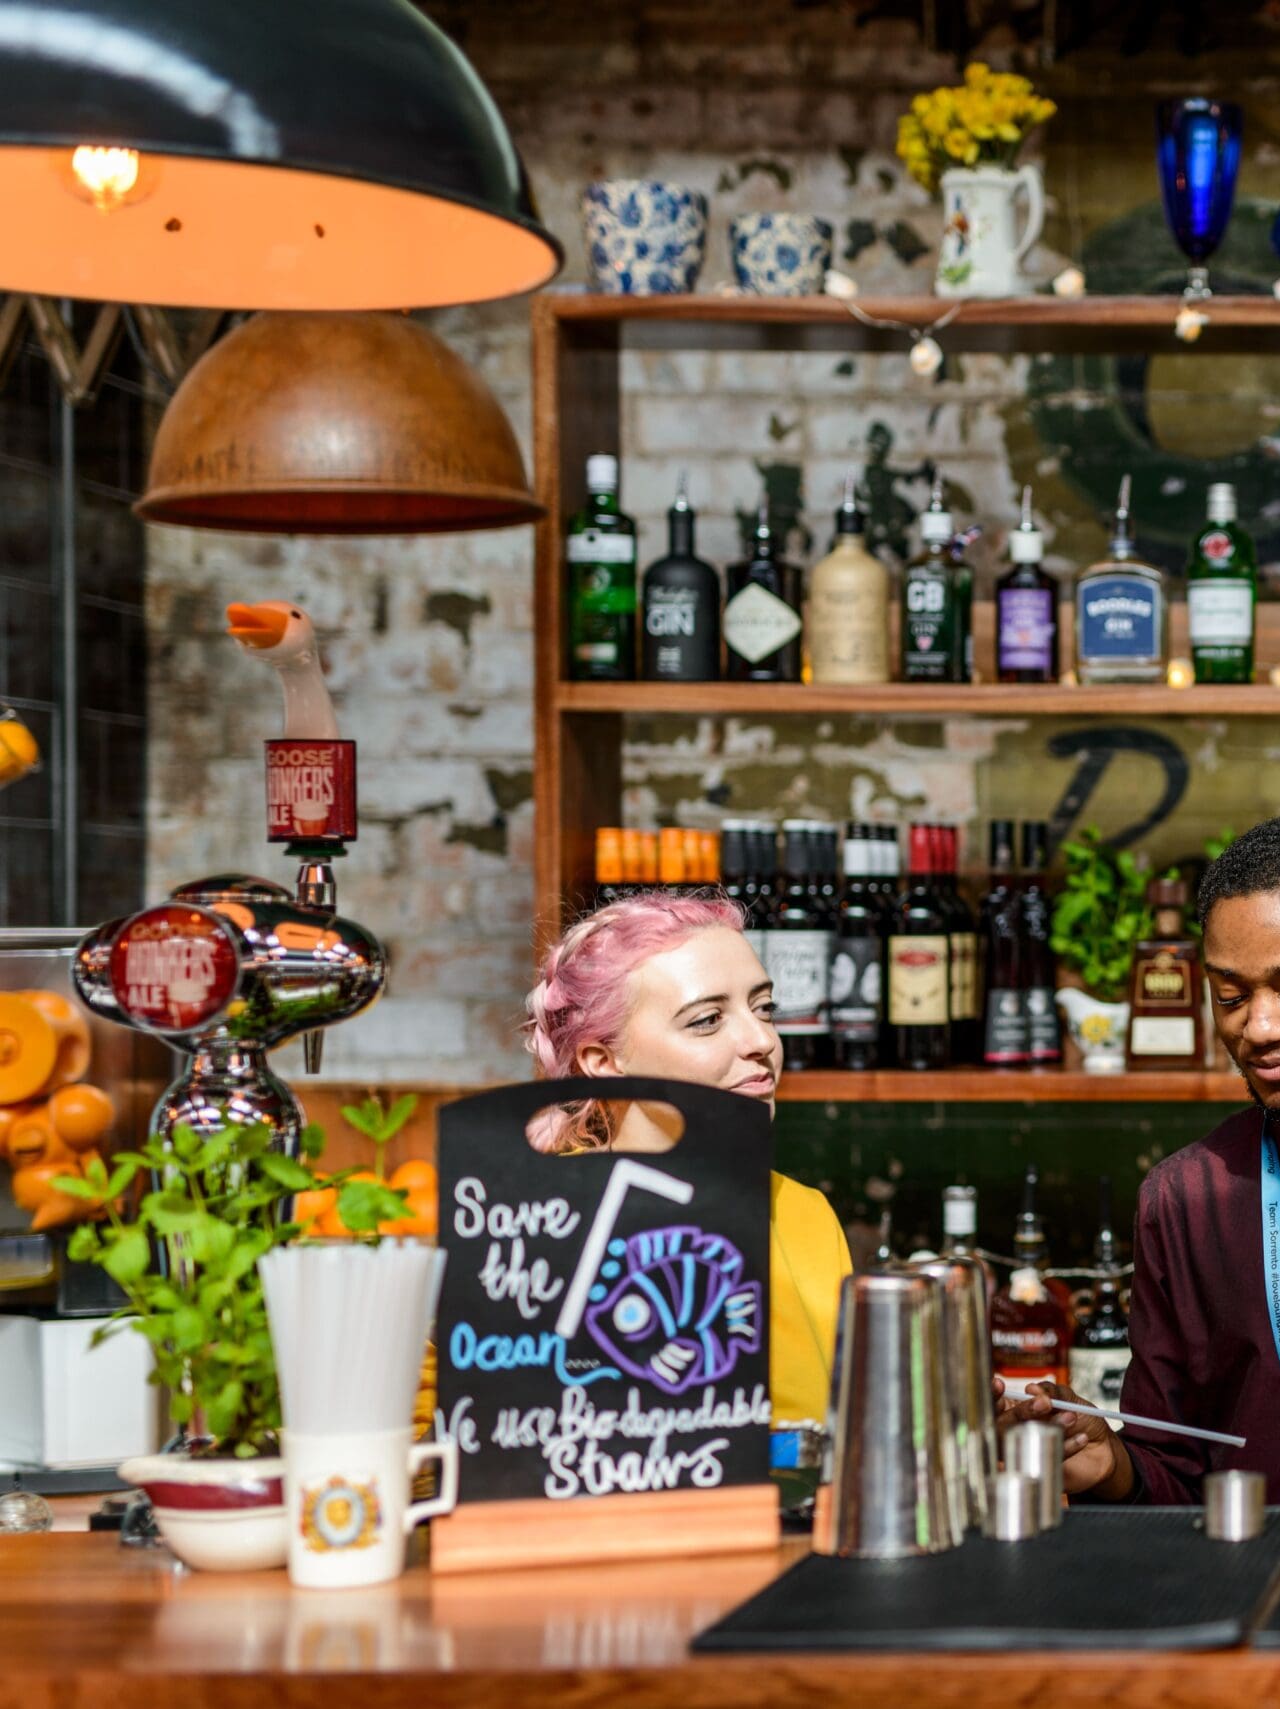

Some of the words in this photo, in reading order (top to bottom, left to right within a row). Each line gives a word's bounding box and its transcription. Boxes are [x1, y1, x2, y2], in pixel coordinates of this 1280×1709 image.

[646, 602, 695, 636] GIN
[266, 766, 335, 806] ONKERS
[127, 984, 165, 1009] ALE
[453, 1176, 582, 1240] Save
[1268, 1200, 1279, 1228] Team
[1269, 1230, 1279, 1270] Sorrento
[477, 1236, 565, 1321] the
[449, 1321, 622, 1387] Ocean
[491, 1405, 561, 1451] use
[542, 1437, 731, 1499] Straws
